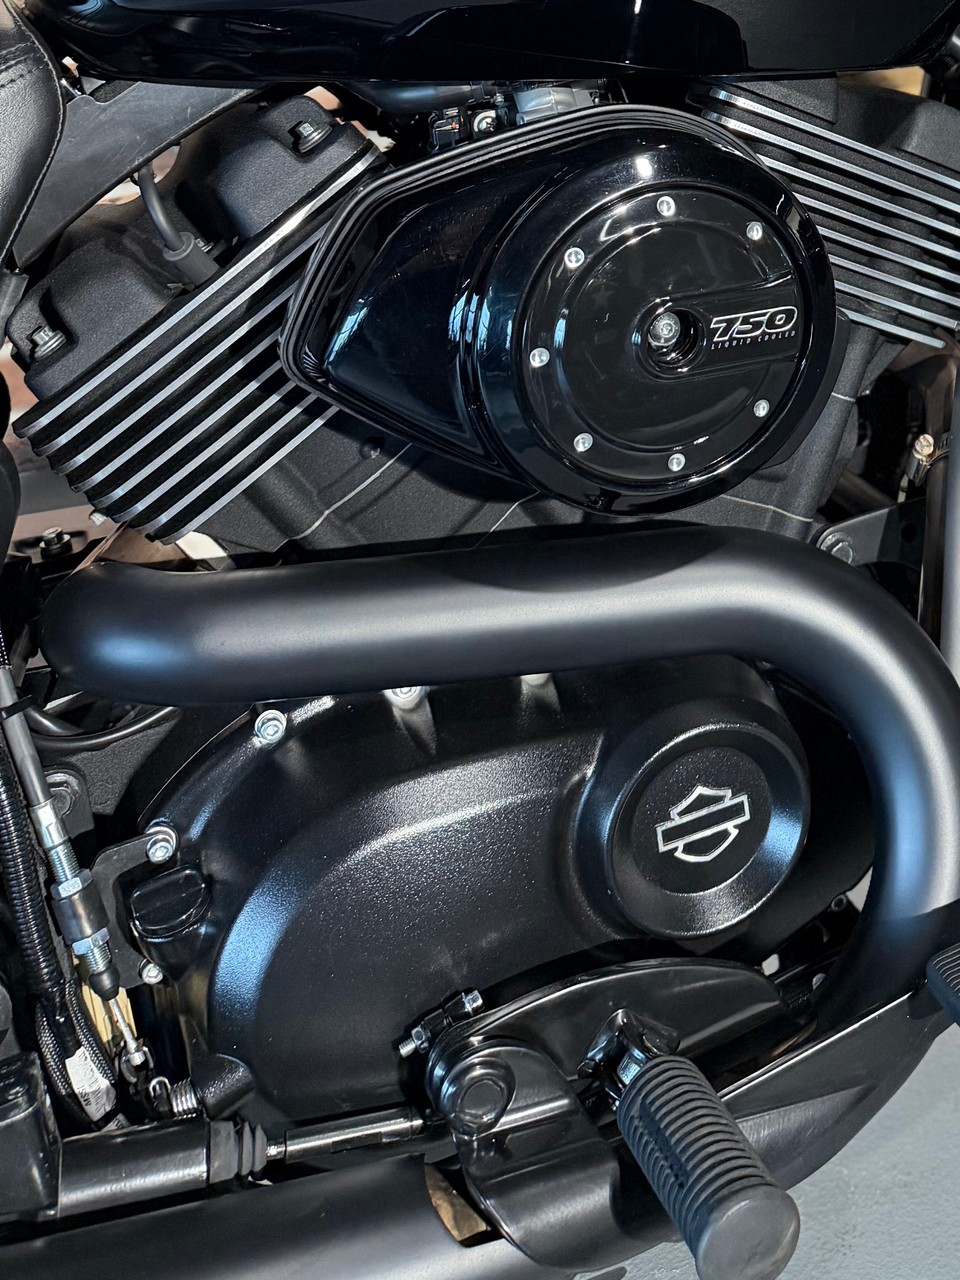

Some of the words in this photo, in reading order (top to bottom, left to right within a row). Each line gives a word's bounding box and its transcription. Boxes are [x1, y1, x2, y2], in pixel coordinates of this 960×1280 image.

[709, 305, 798, 342] 750
[711, 338, 752, 351] LIQUID
[757, 330, 796, 342] COOLED
